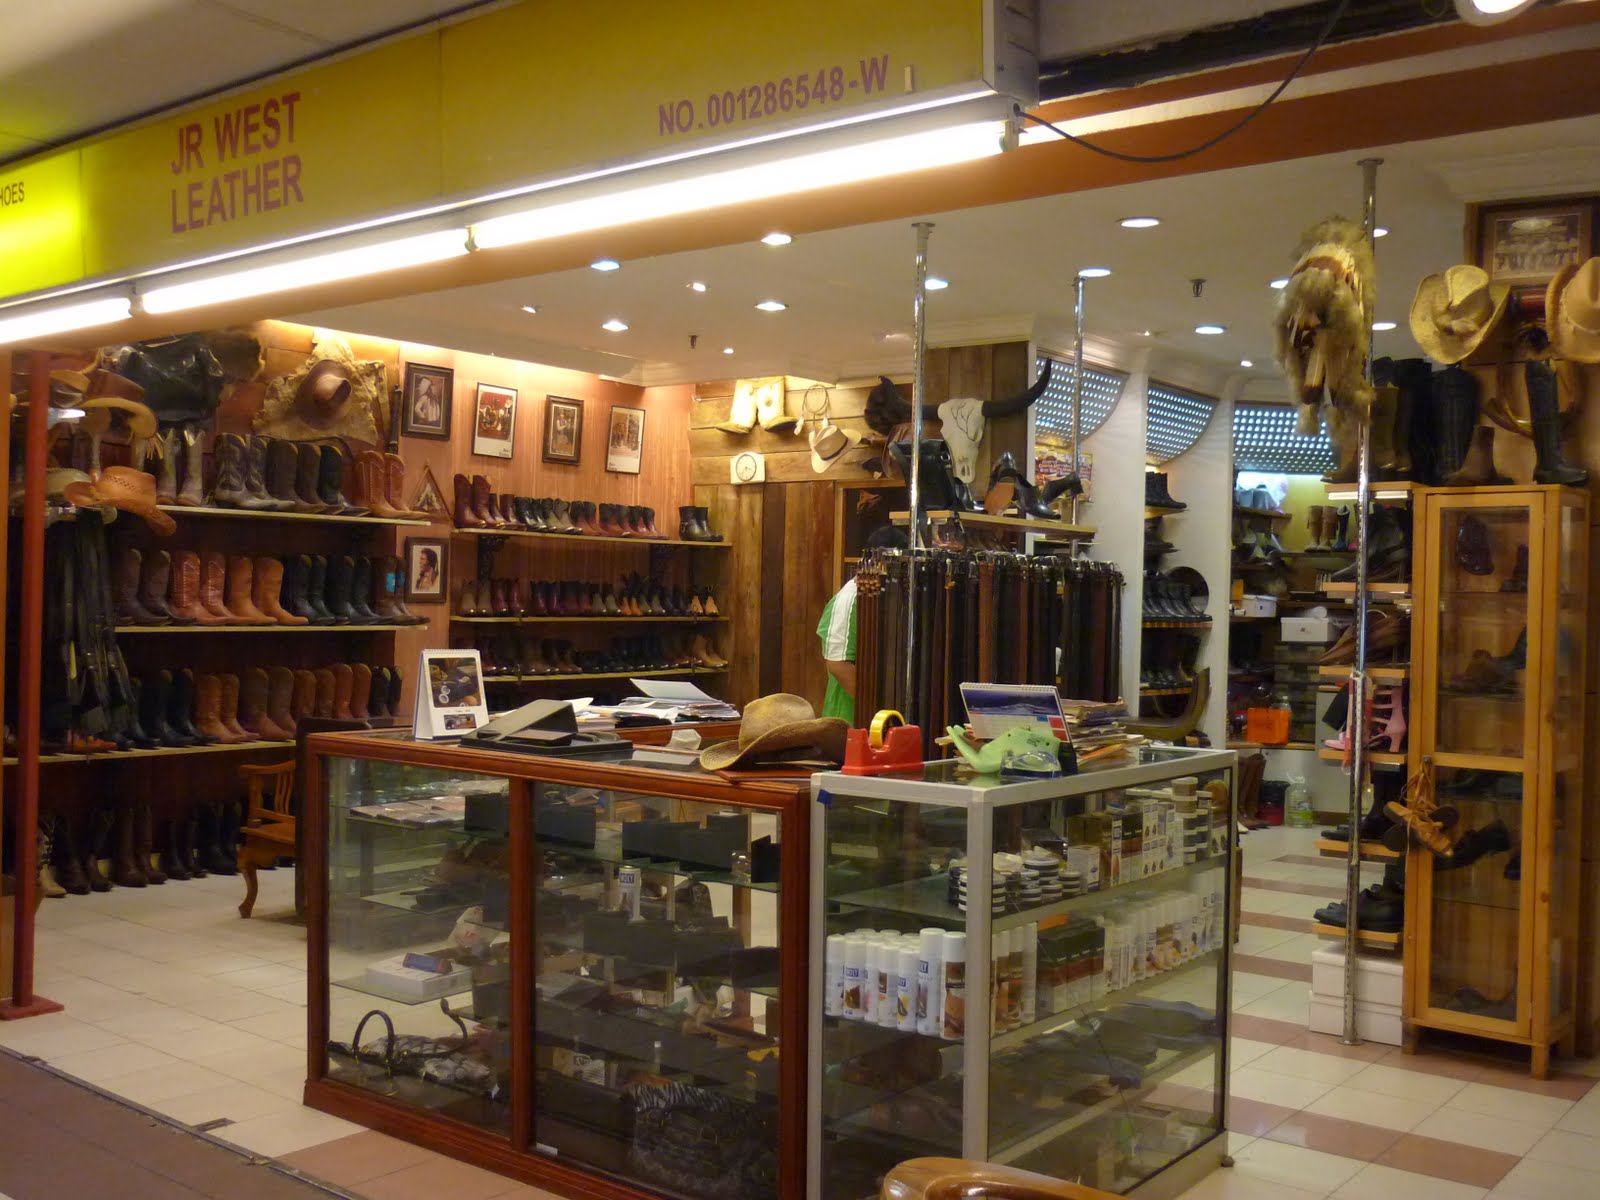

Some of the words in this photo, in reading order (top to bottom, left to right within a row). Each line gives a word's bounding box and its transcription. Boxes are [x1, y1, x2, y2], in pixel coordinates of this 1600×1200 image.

[171, 123, 204, 175] JR
[214, 92, 301, 162] WEST
[171, 154, 304, 234] LEATHER
